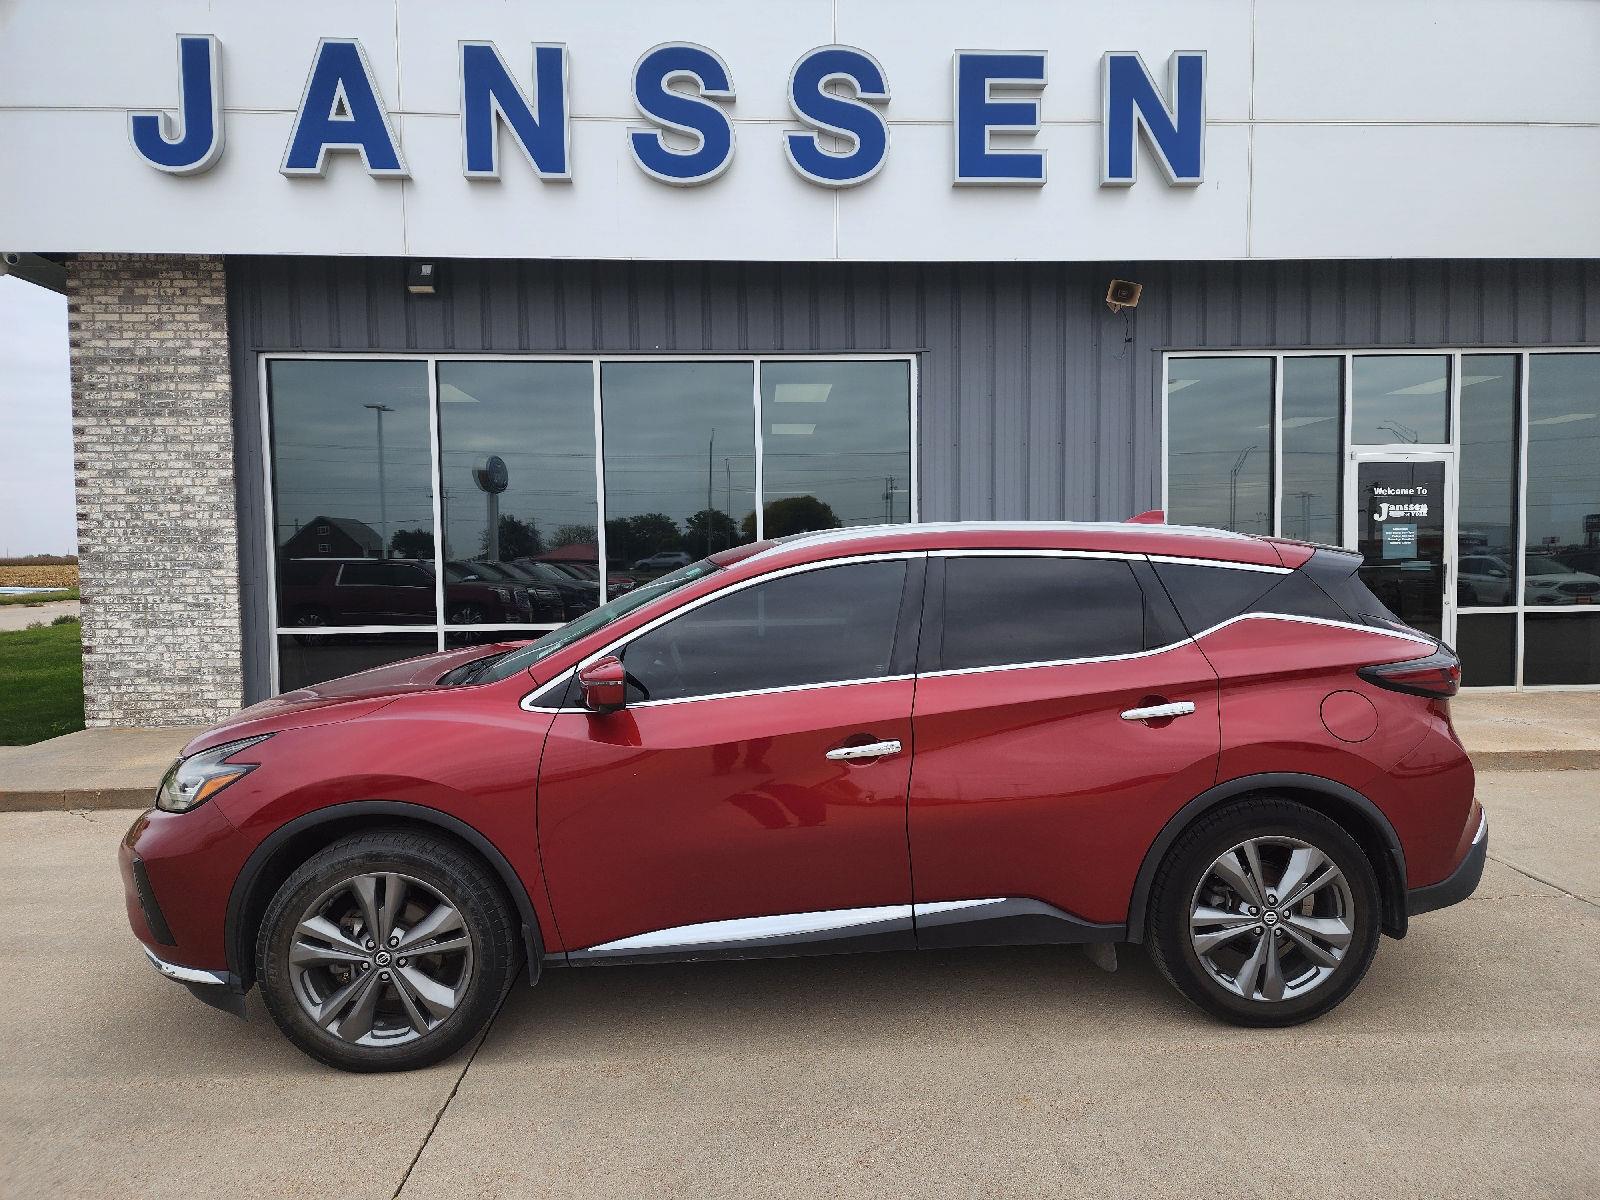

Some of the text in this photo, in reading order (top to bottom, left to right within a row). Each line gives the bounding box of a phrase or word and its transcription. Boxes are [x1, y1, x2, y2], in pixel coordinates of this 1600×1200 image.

[128, 34, 1207, 188] JANSSEN
[1374, 487, 1428, 495] Welcome To
[1373, 503, 1428, 521] Janssen
